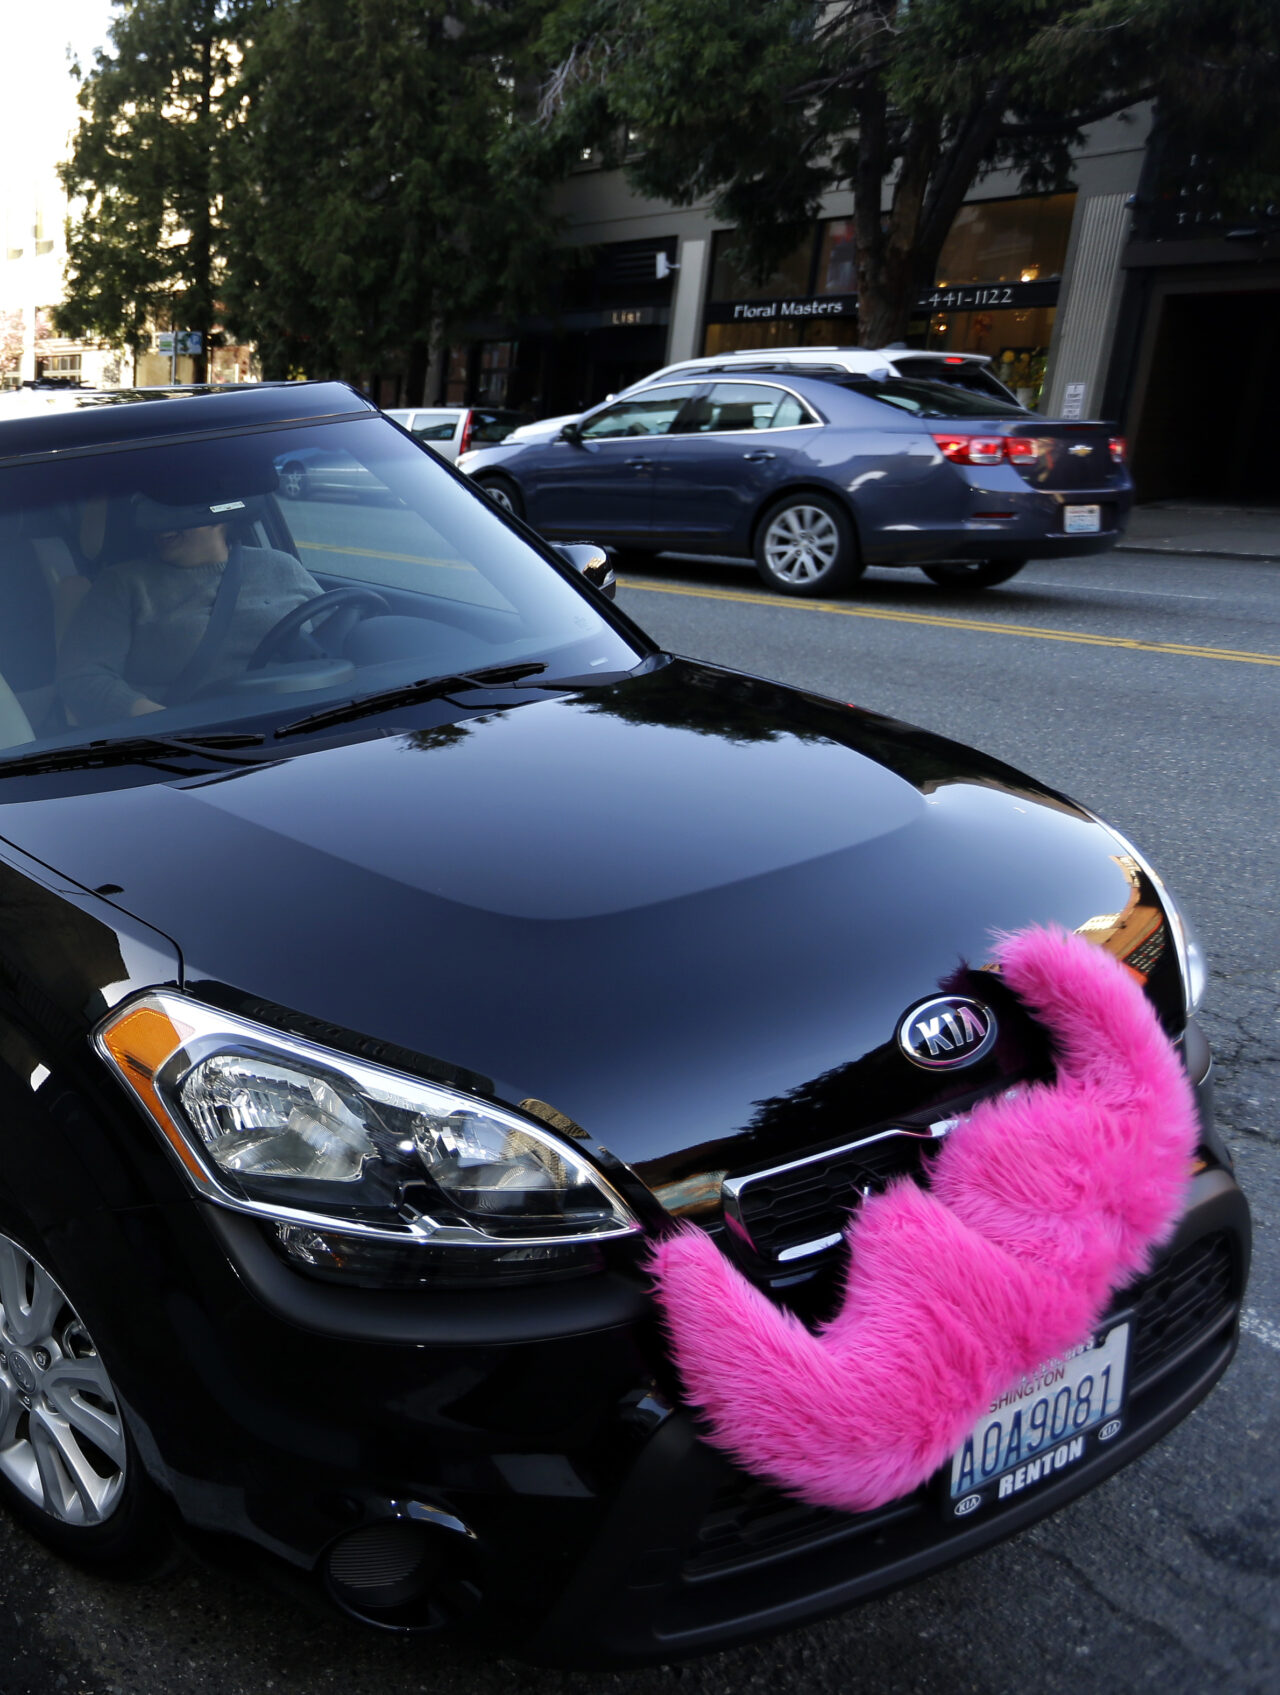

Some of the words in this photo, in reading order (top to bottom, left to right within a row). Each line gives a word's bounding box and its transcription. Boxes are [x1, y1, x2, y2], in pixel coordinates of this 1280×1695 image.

[612, 311, 641, 324] List
[734, 304, 776, 318] Floral
[780, 301, 842, 316] Masters
[918, 288, 1013, 307] -441-1122
[915, 1006, 986, 1056] KIA
[989, 1366, 1065, 1413] SHINGTON
[1100, 1422, 1119, 1438] KIA
[998, 1435, 1084, 1499] RENTON
[957, 1496, 980, 1513] KIA
